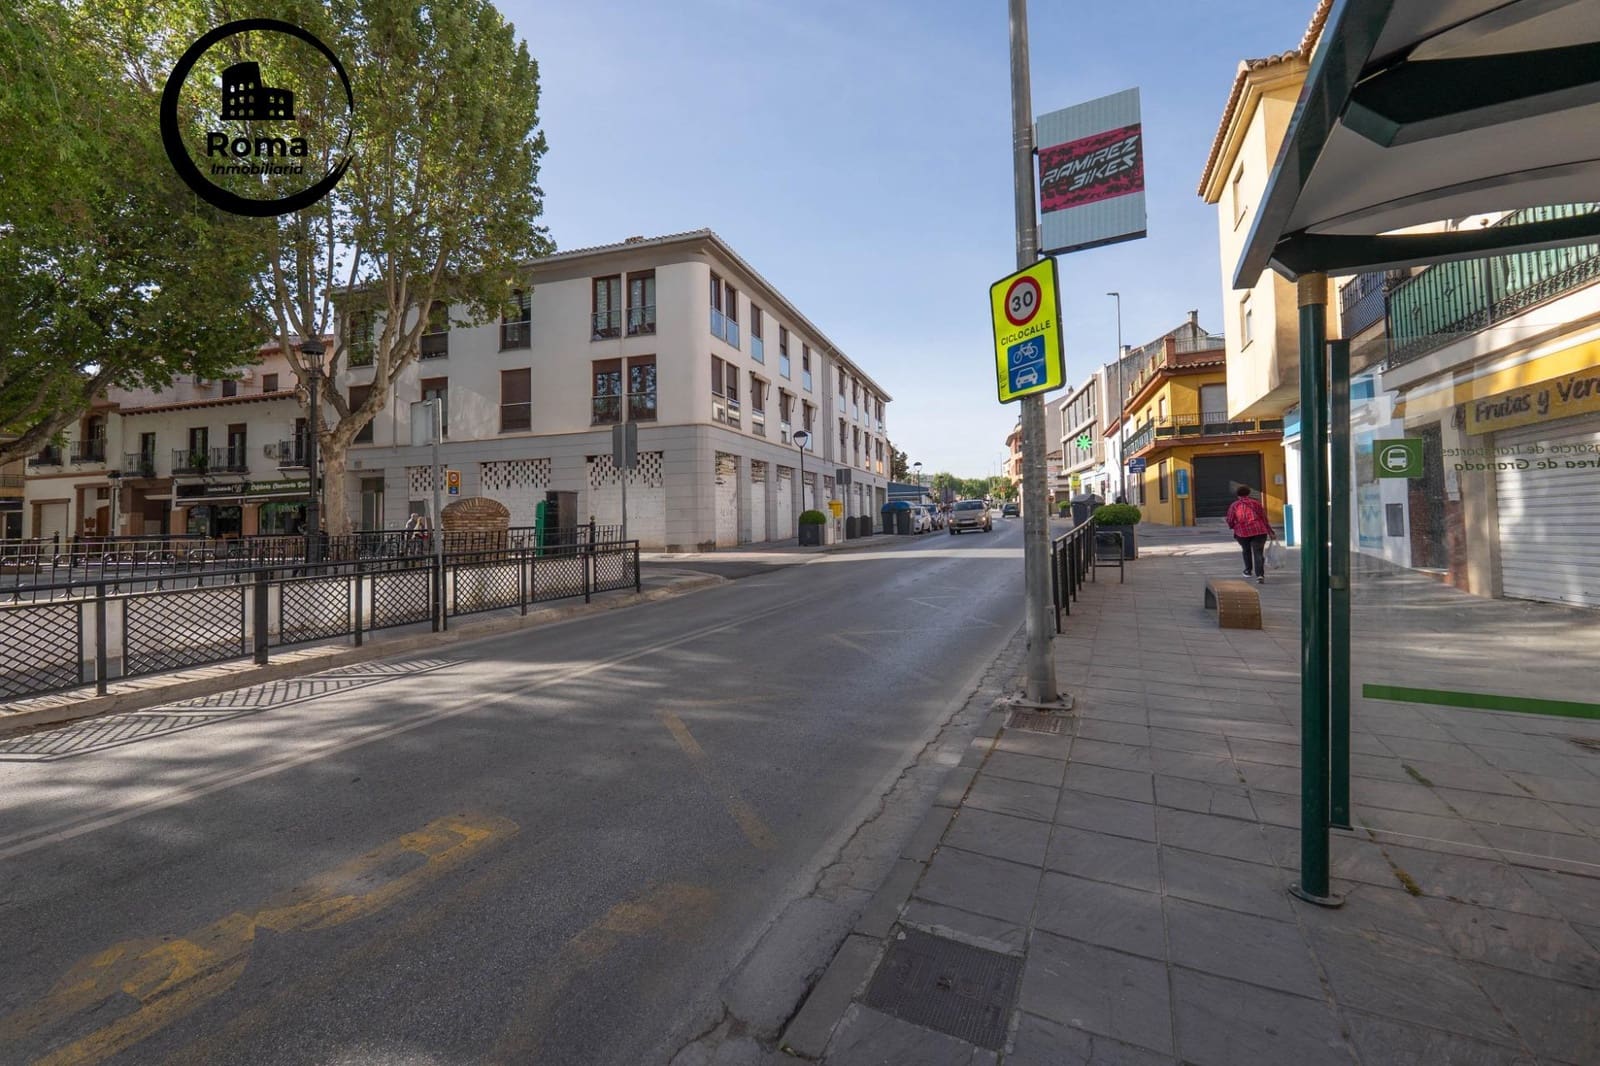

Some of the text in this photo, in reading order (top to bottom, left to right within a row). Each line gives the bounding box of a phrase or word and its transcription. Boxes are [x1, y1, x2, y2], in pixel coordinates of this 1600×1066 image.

[1041, 135, 1139, 187] RAMIREZ
[1069, 152, 1137, 191] BIKES
[1011, 291, 1034, 312] 30
[1000, 320, 1051, 345] CICLOCALLE
[1475, 393, 1531, 422] Frutas
[1537, 390, 1550, 415] y
